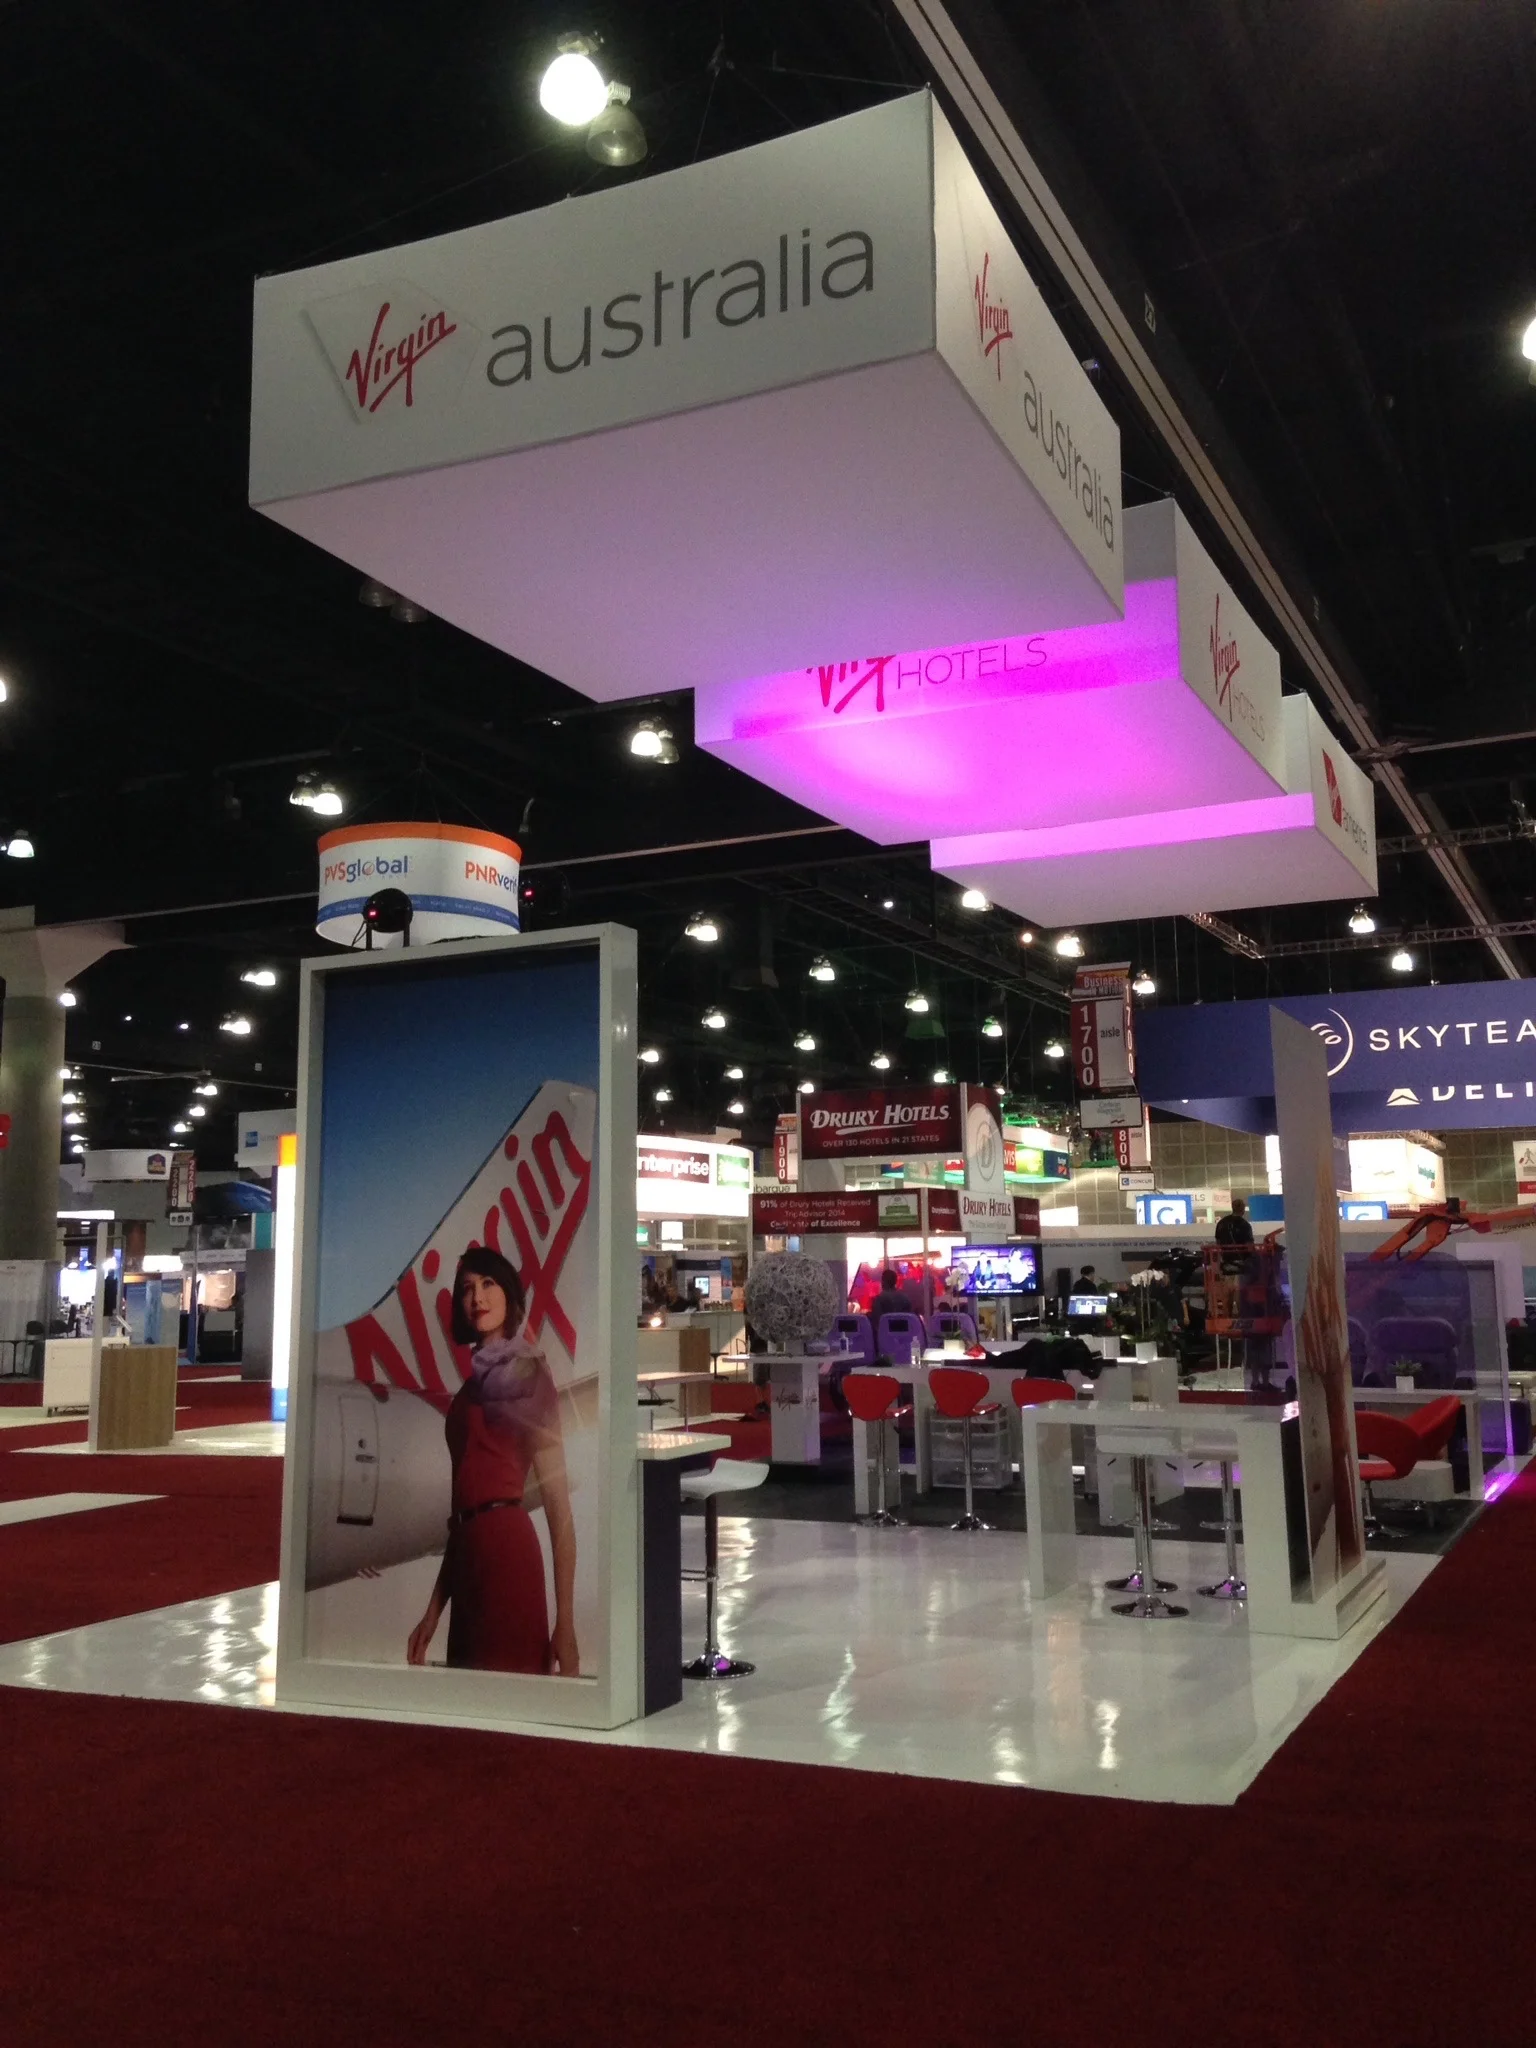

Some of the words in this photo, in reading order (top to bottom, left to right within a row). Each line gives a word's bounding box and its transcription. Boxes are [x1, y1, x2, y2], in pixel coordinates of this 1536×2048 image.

[346, 302, 456, 412] Virgin
[486, 228, 874, 387] australia
[974, 252, 1013, 382] Virgin
[1023, 369, 1114, 553] australia
[897, 637, 1047, 689] HOTELS
[1209, 593, 1240, 722] Virgin
[1080, 1005, 1095, 1086] 1700
[1100, 1027, 1120, 1038] aisle
[637, 1154, 709, 1178] nterprise
[777, 1136, 786, 1179] 1900
[822, 1140, 843, 1148] OVER
[859, 1137, 890, 1146] HOTELS
[891, 1136, 900, 1144] IN
[911, 1134, 940, 1143] STATES
[760, 1199, 778, 1209] 91%
[820, 1219, 861, 1228] Excellence
[345, 1110, 592, 1415] Vigin
